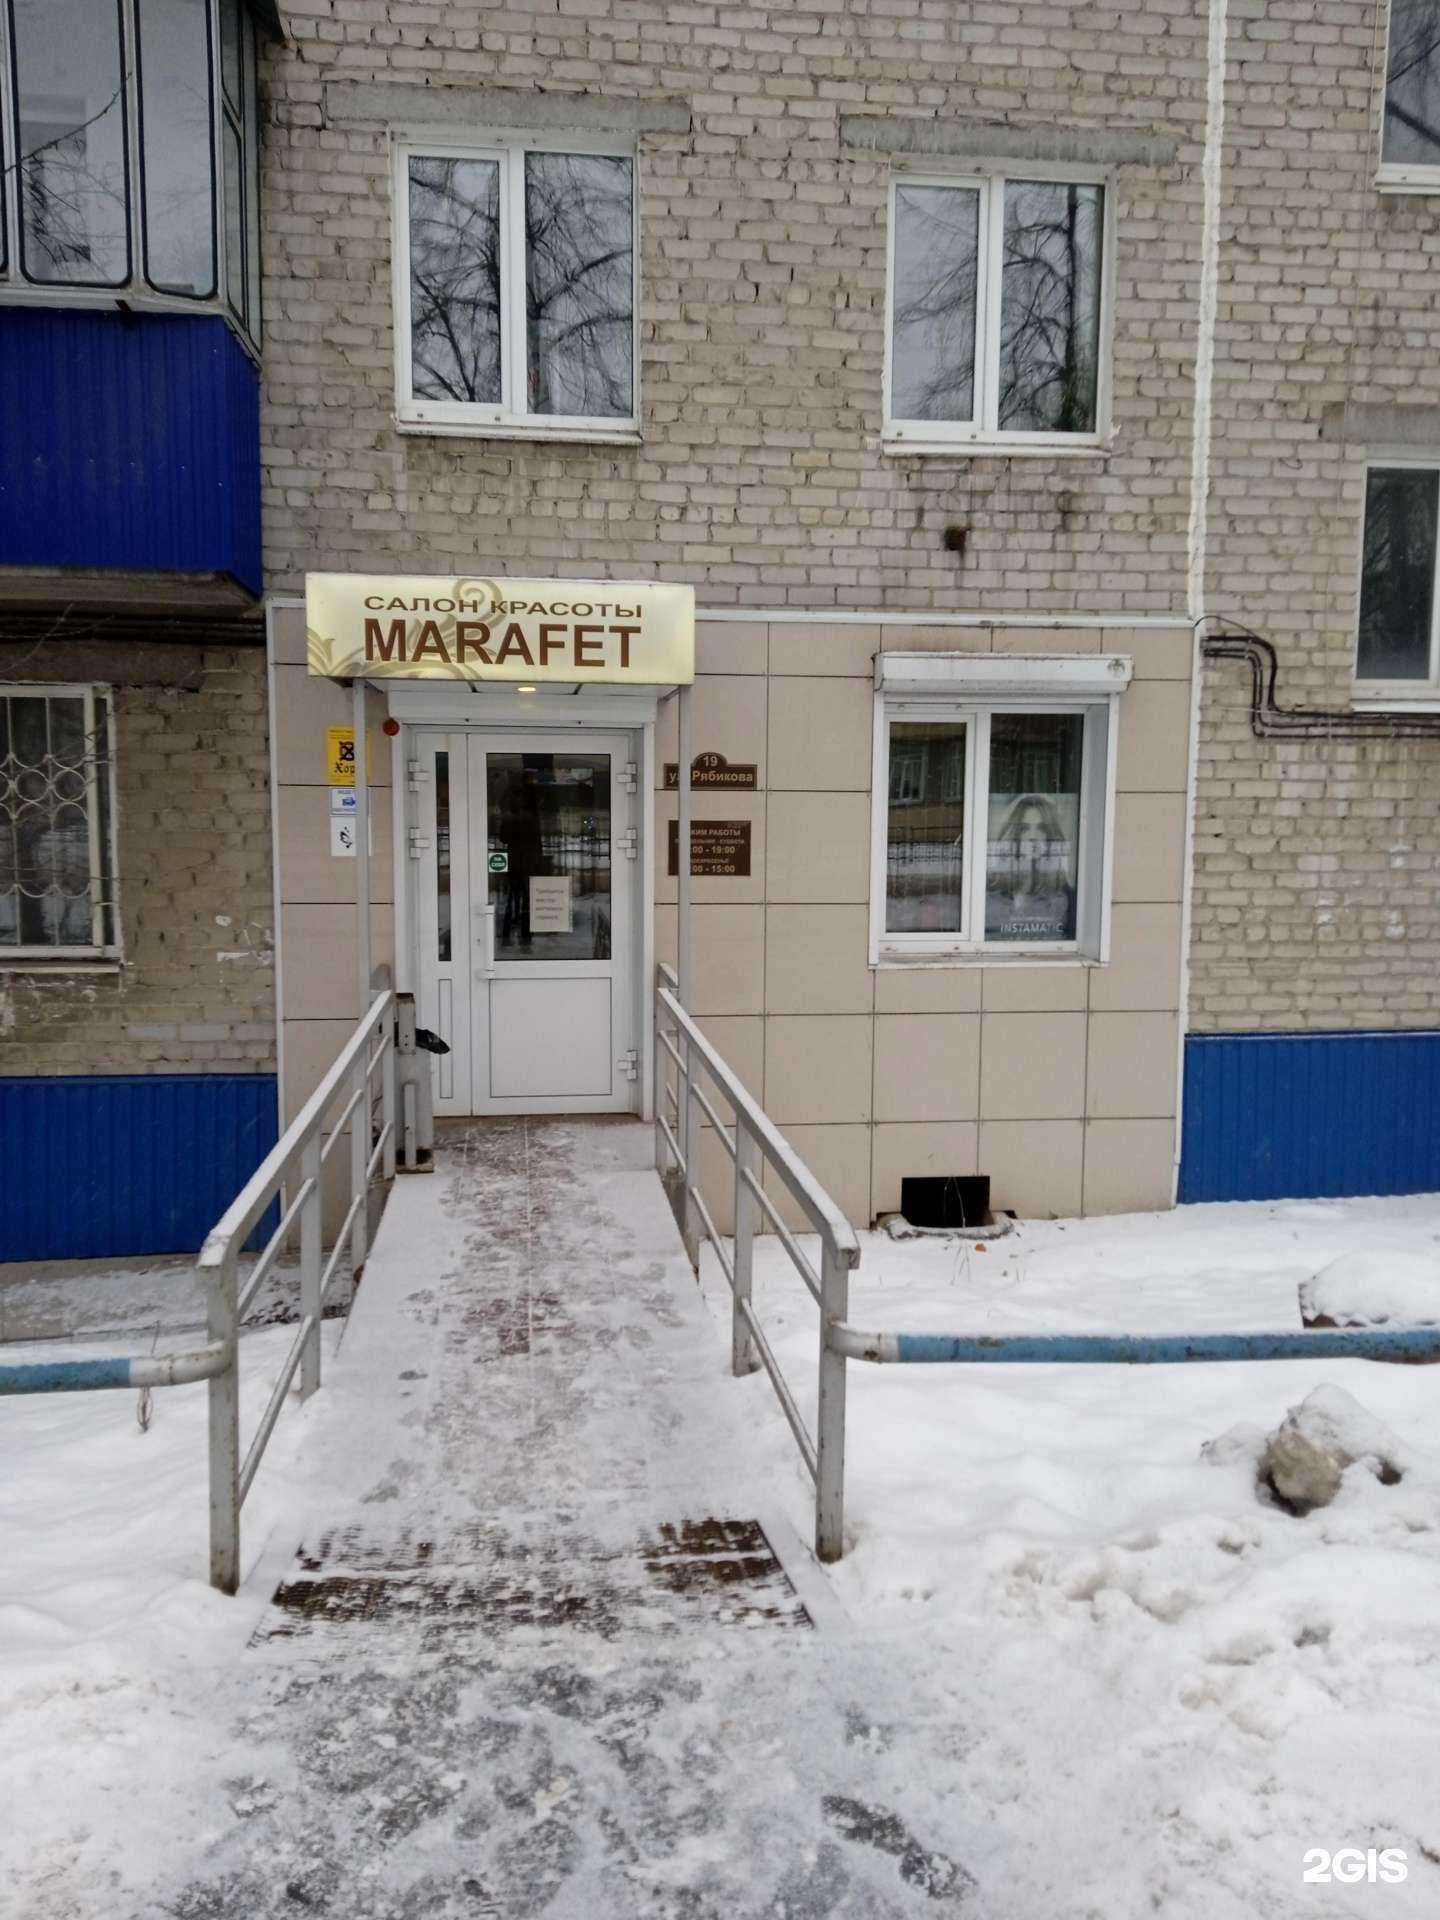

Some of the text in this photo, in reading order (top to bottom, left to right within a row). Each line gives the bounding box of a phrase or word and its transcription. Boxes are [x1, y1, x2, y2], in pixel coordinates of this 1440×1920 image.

[364, 596, 642, 618] САЛОН КРАСОТЫ
[364, 618, 642, 668] MARAFET
[703, 755, 718, 767] 19
[692, 770, 753, 782] Рябикова
